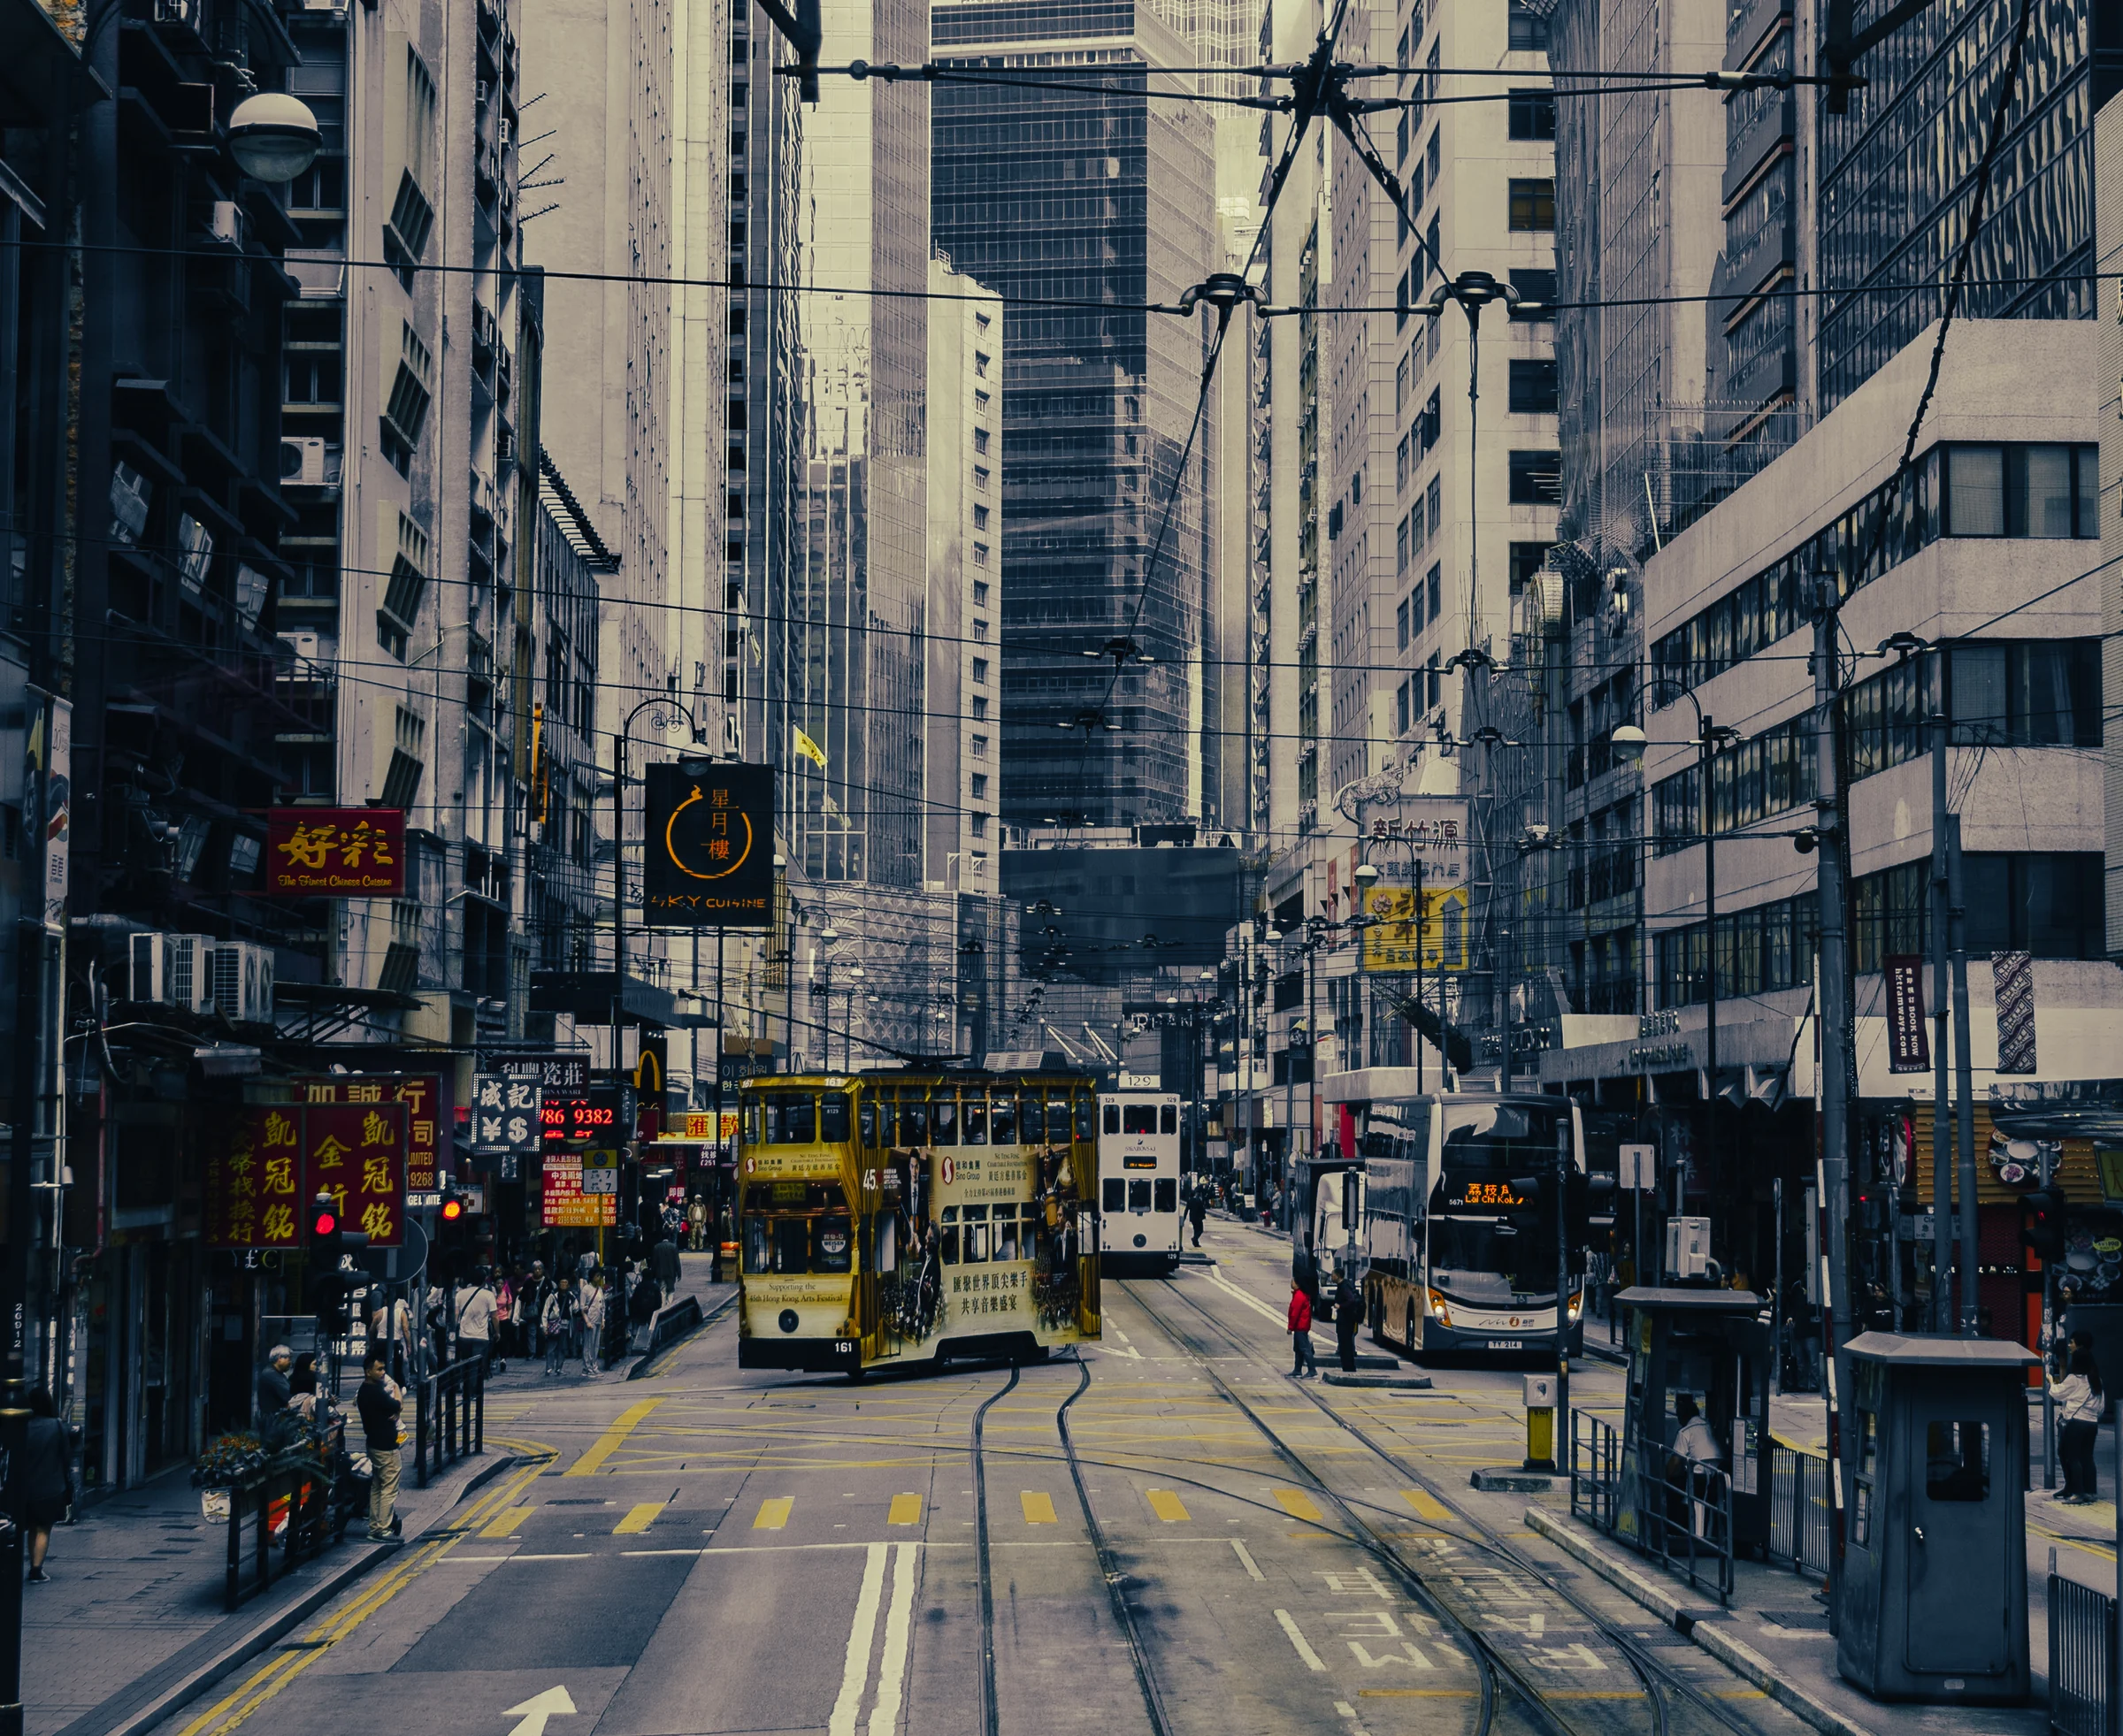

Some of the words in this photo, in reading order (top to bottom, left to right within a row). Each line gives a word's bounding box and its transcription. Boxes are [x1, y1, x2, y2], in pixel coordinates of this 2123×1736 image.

[701, 789, 740, 860] 星月樓
[1372, 817, 1459, 851] 新竹源
[277, 821, 394, 869] 好彩
[278, 875, 296, 887] The
[298, 875, 327, 887] Finest
[329, 875, 360, 887] Chinese
[362, 875, 393, 887] Cuisine
[705, 899, 766, 908] CUISINE
[1895, 967, 1908, 1057] hktramways.com
[1908, 1006, 1917, 1033] BOOK
[1128, 1076, 1151, 1086] 129
[480, 1081, 534, 1112] 成記
[573, 1108, 613, 1125] 9382
[508, 1116, 528, 1143] $
[262, 1110, 297, 1241] 凱冠銘
[360, 1110, 395, 1240] 凱冠銘
[410, 1172, 433, 1187] 9268
[605, 1170, 612, 1179] 7
[967, 1172, 981, 1181] Group
[1482, 1195, 1495, 1204] Chi
[1498, 1194, 1514, 1204] Kok
[244, 1250, 258, 1269] £
[954, 1270, 1027, 1293] 匯聚世界頂尖樂手
[763, 1294, 780, 1304] Hong
[782, 1294, 800, 1304] Kong
[816, 1294, 843, 1303] Festival
[962, 1294, 1017, 1315] 共享音樂盛宴
[13, 1303, 23, 1348] 26912
[835, 1342, 852, 1353] 161
